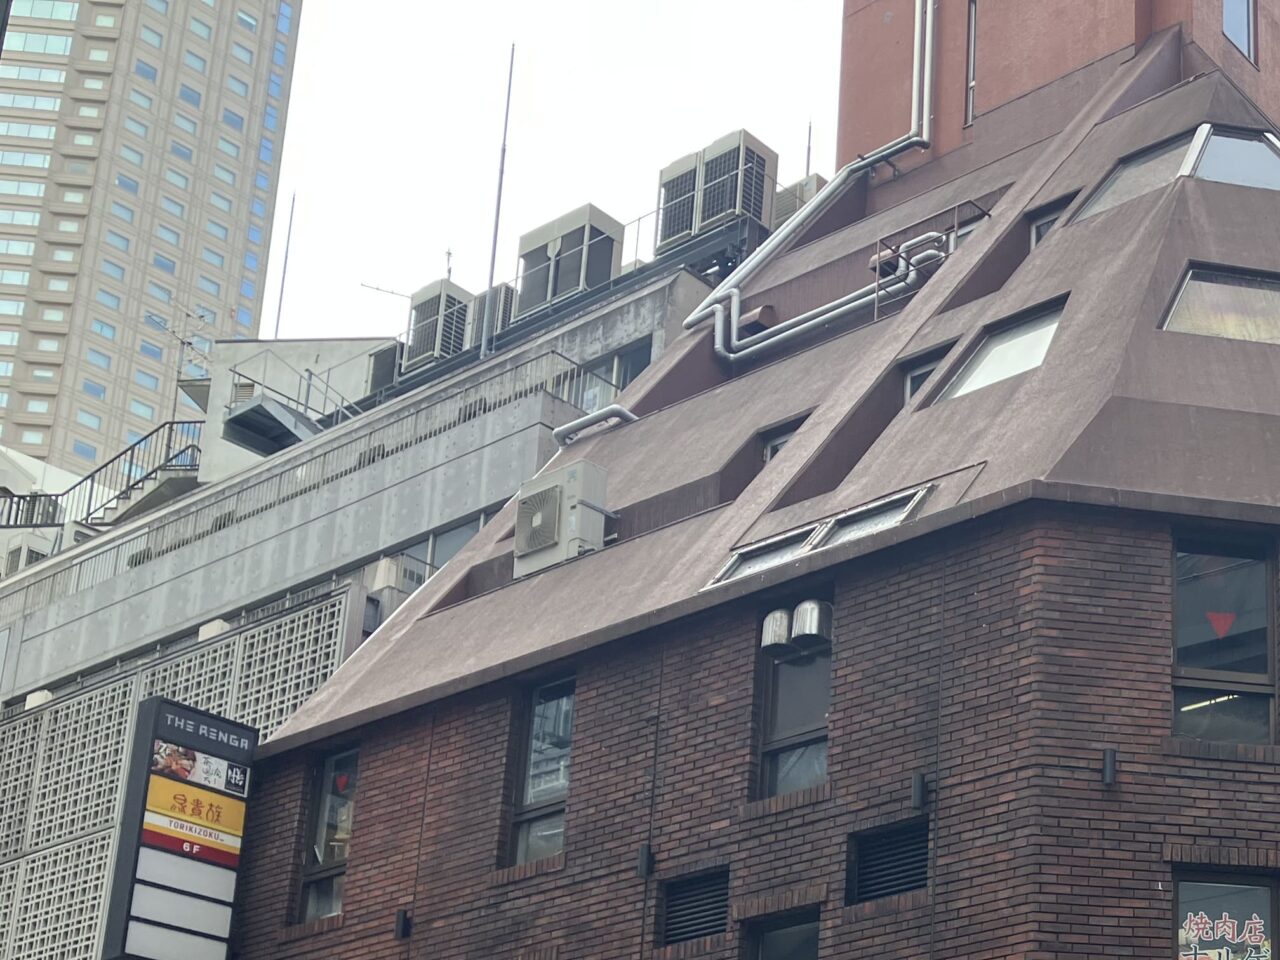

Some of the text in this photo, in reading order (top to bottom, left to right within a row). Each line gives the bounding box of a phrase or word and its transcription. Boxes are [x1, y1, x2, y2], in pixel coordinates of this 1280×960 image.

[165, 713, 248, 750] THE RENGA
[170, 793, 223, 823] 鳥貴族
[169, 819, 220, 841] TORIKIZOKU
[1182, 911, 1265, 946] 焼肉店
